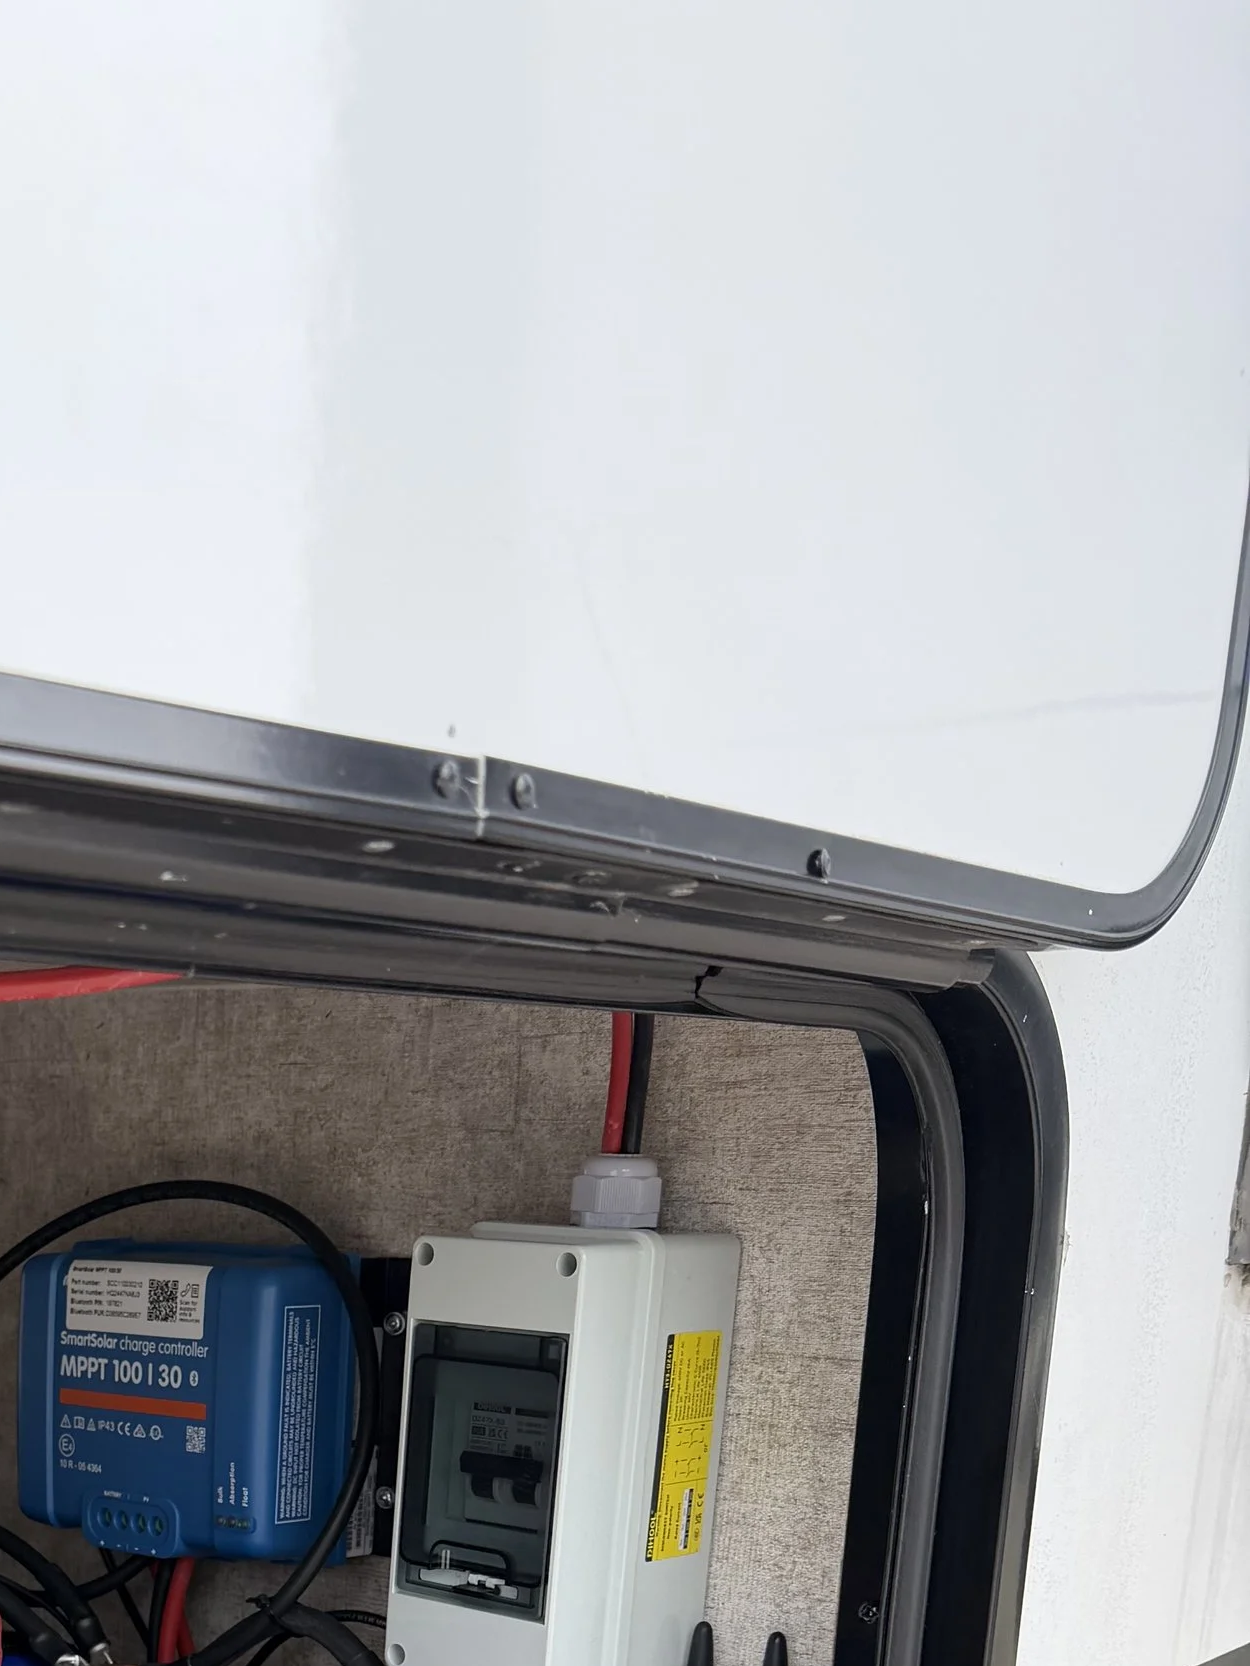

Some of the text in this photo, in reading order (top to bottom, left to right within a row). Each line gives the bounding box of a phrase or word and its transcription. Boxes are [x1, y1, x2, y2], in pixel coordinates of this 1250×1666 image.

[60, 1331, 208, 1358] SmartSolar charge controller
[60, 1355, 182, 1389] MPPT 100 30
[647, 1516, 656, 1558] DIHOOL
